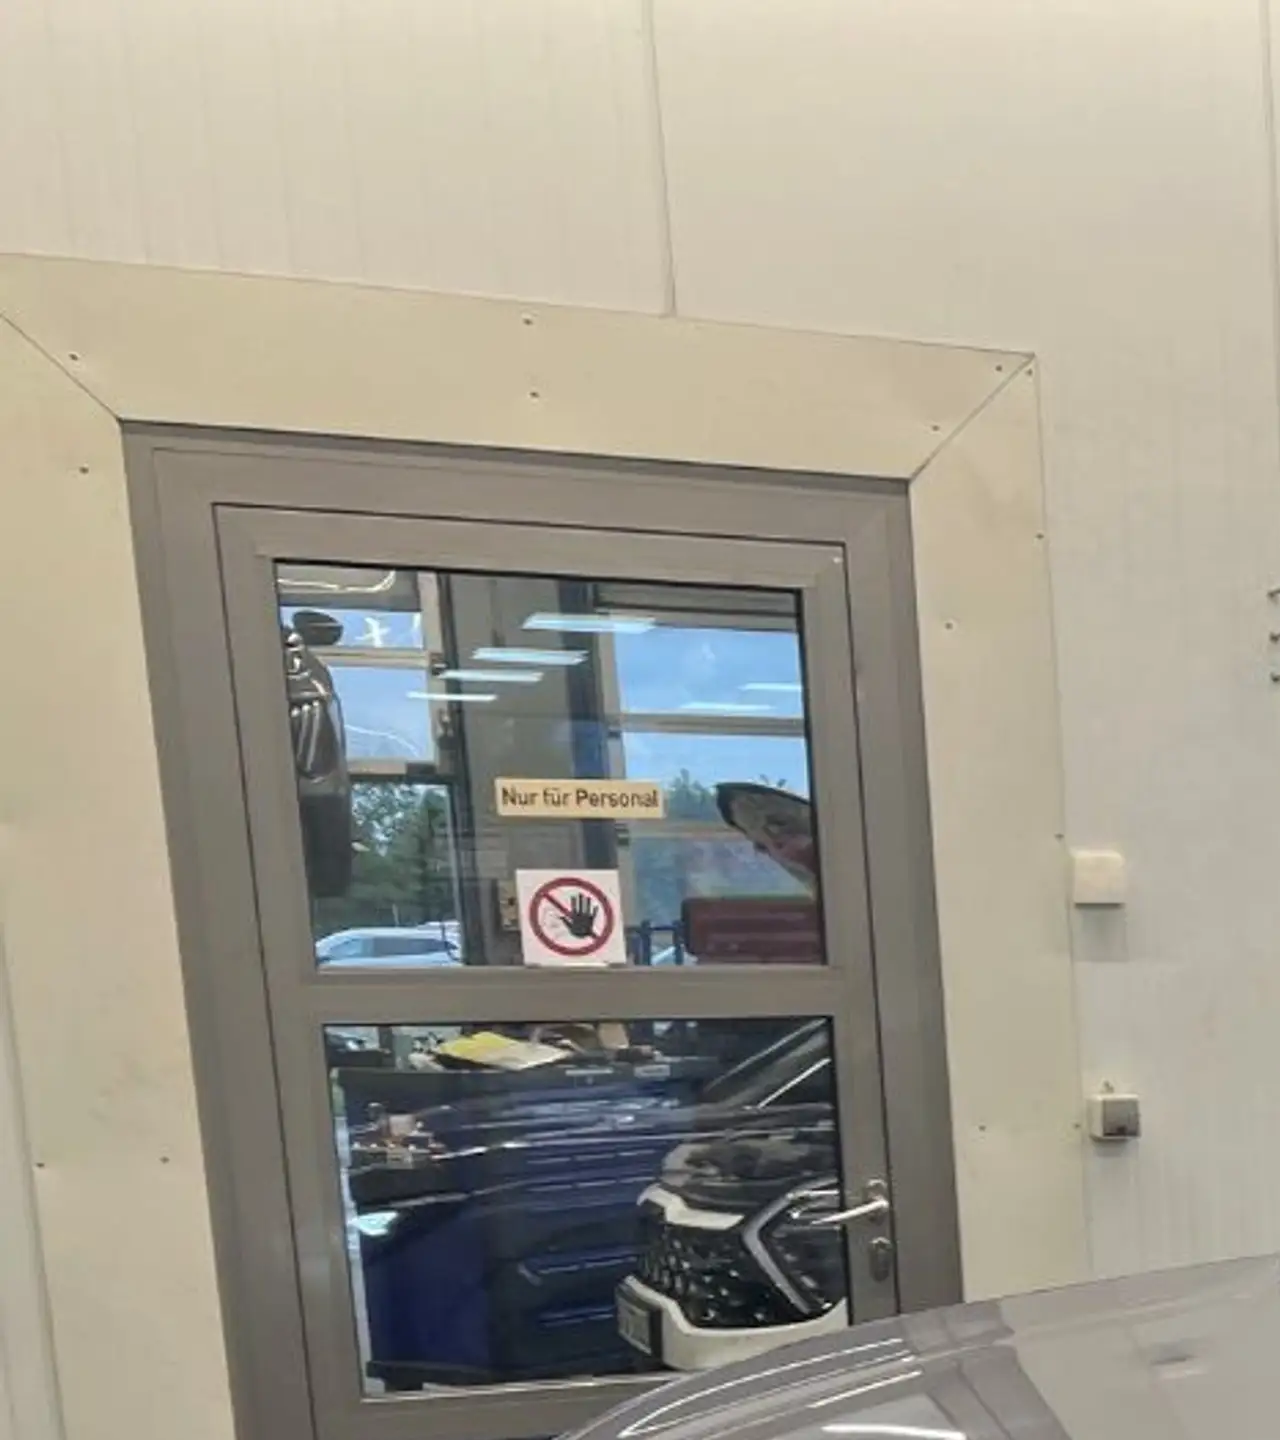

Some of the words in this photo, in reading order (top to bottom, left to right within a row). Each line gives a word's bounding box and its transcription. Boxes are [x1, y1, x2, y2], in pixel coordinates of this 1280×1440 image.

[502, 787, 537, 806] Nur
[544, 787, 569, 806] für
[576, 788, 659, 808] Personal
